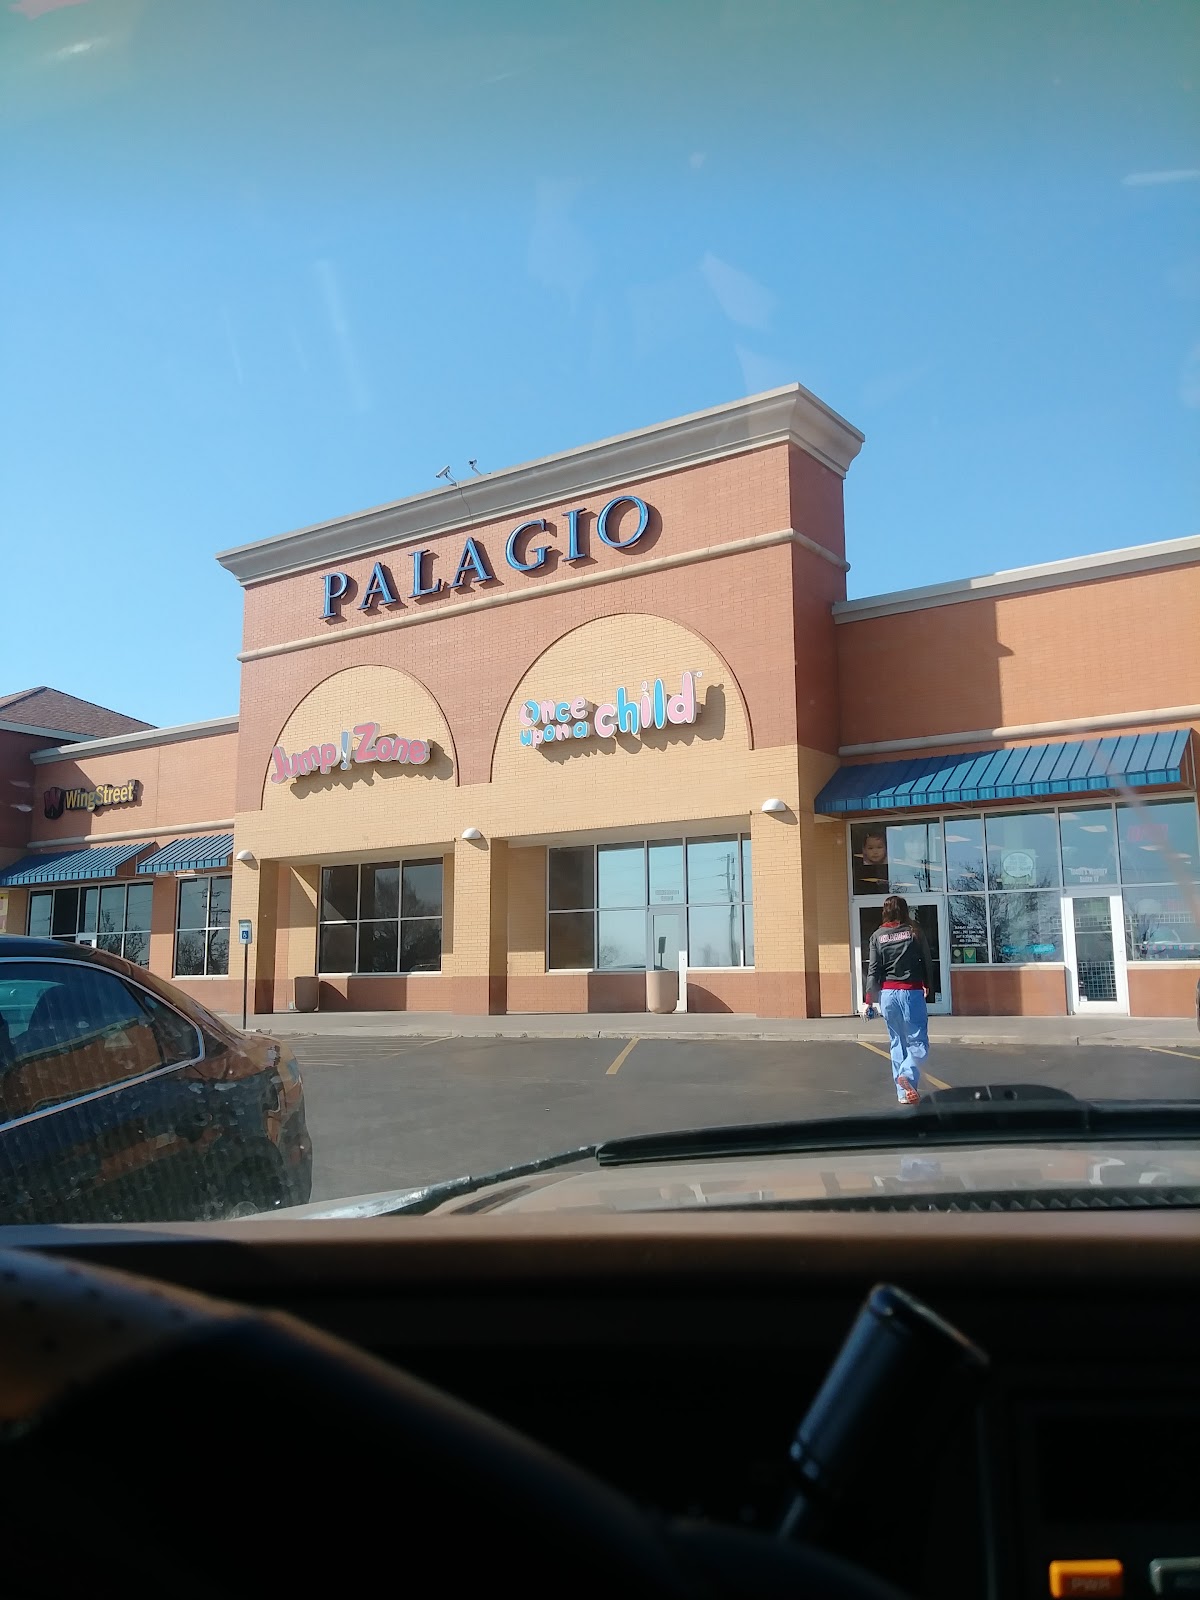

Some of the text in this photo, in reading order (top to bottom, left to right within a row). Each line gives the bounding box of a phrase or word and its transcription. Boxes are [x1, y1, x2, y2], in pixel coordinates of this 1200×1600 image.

[319, 495, 650, 619] PALAGIO
[519, 697, 587, 727] Once
[594, 671, 697, 738] child
[353, 722, 430, 765] Zone
[520, 721, 589, 747] upon a
[65, 781, 135, 811] WingStreet
